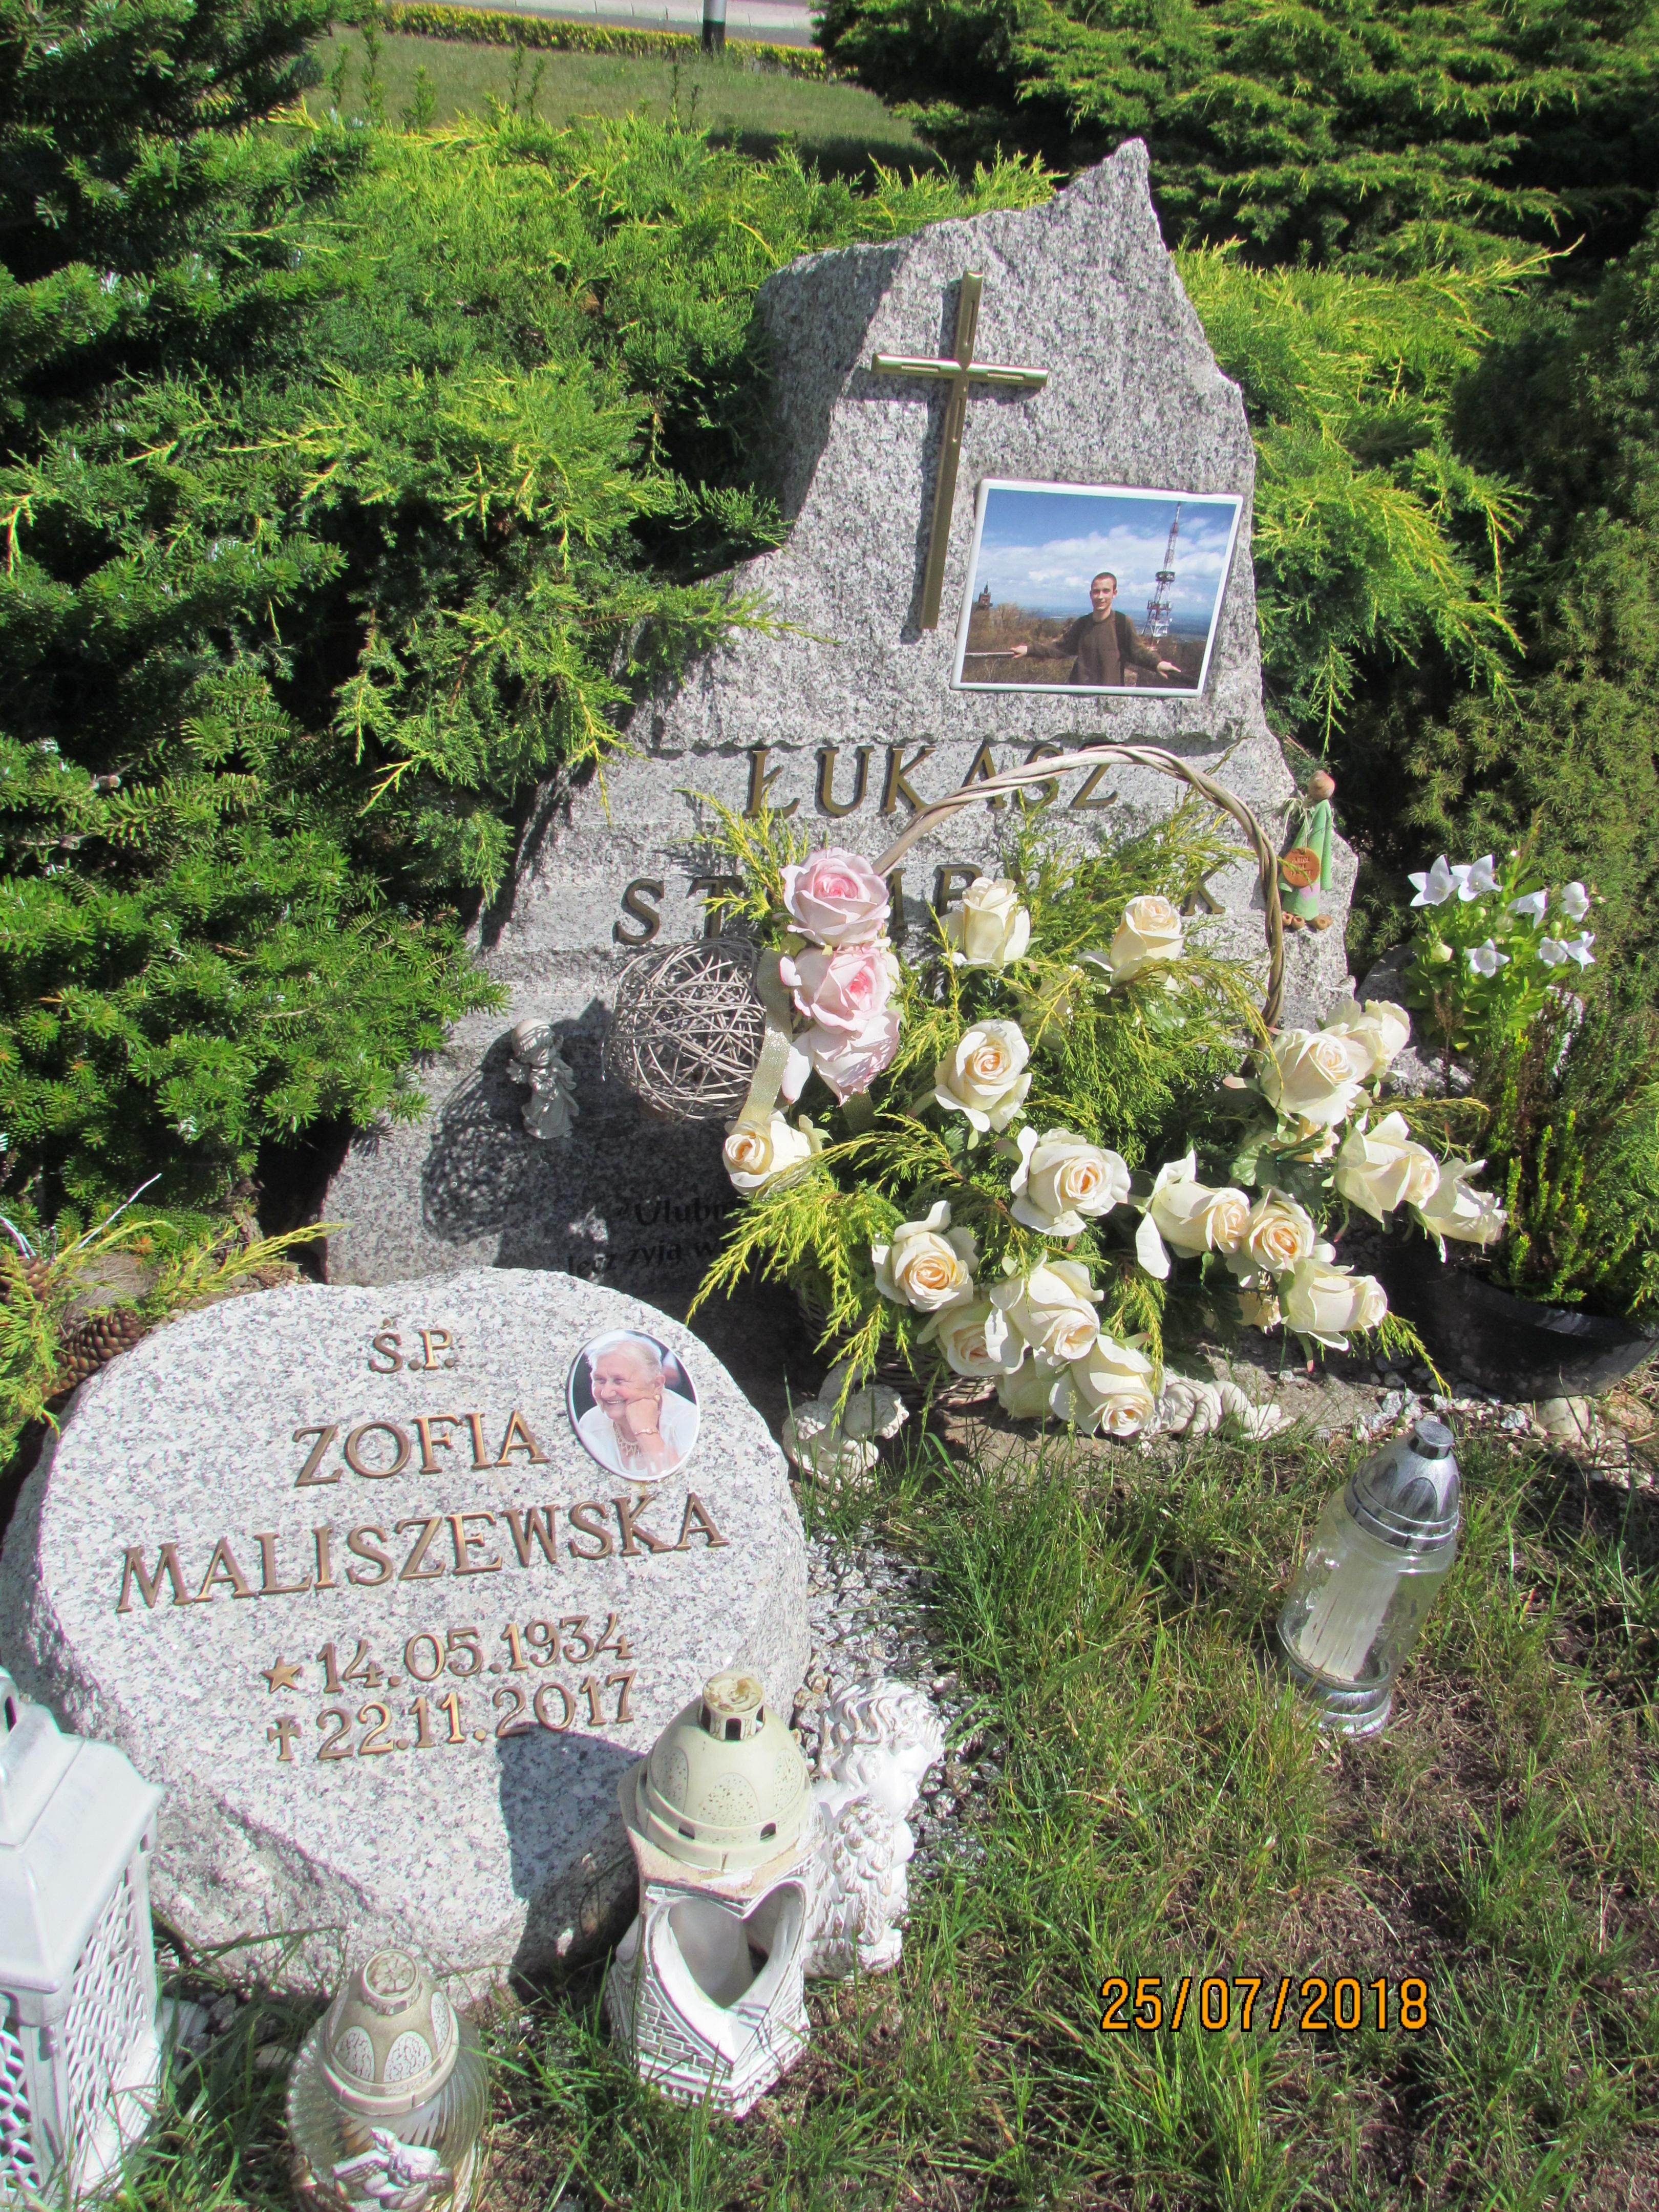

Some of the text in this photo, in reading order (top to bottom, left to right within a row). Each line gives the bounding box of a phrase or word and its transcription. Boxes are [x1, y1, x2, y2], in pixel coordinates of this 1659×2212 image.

[743, 739, 1123, 818] ŁUKASZ
[292, 1409, 551, 1487] ZOFIA
[116, 1491, 730, 1613] MALISZEWSKA
[315, 1611, 634, 1693] 14.05.1934
[316, 1669, 639, 1760] 22.11.2017
